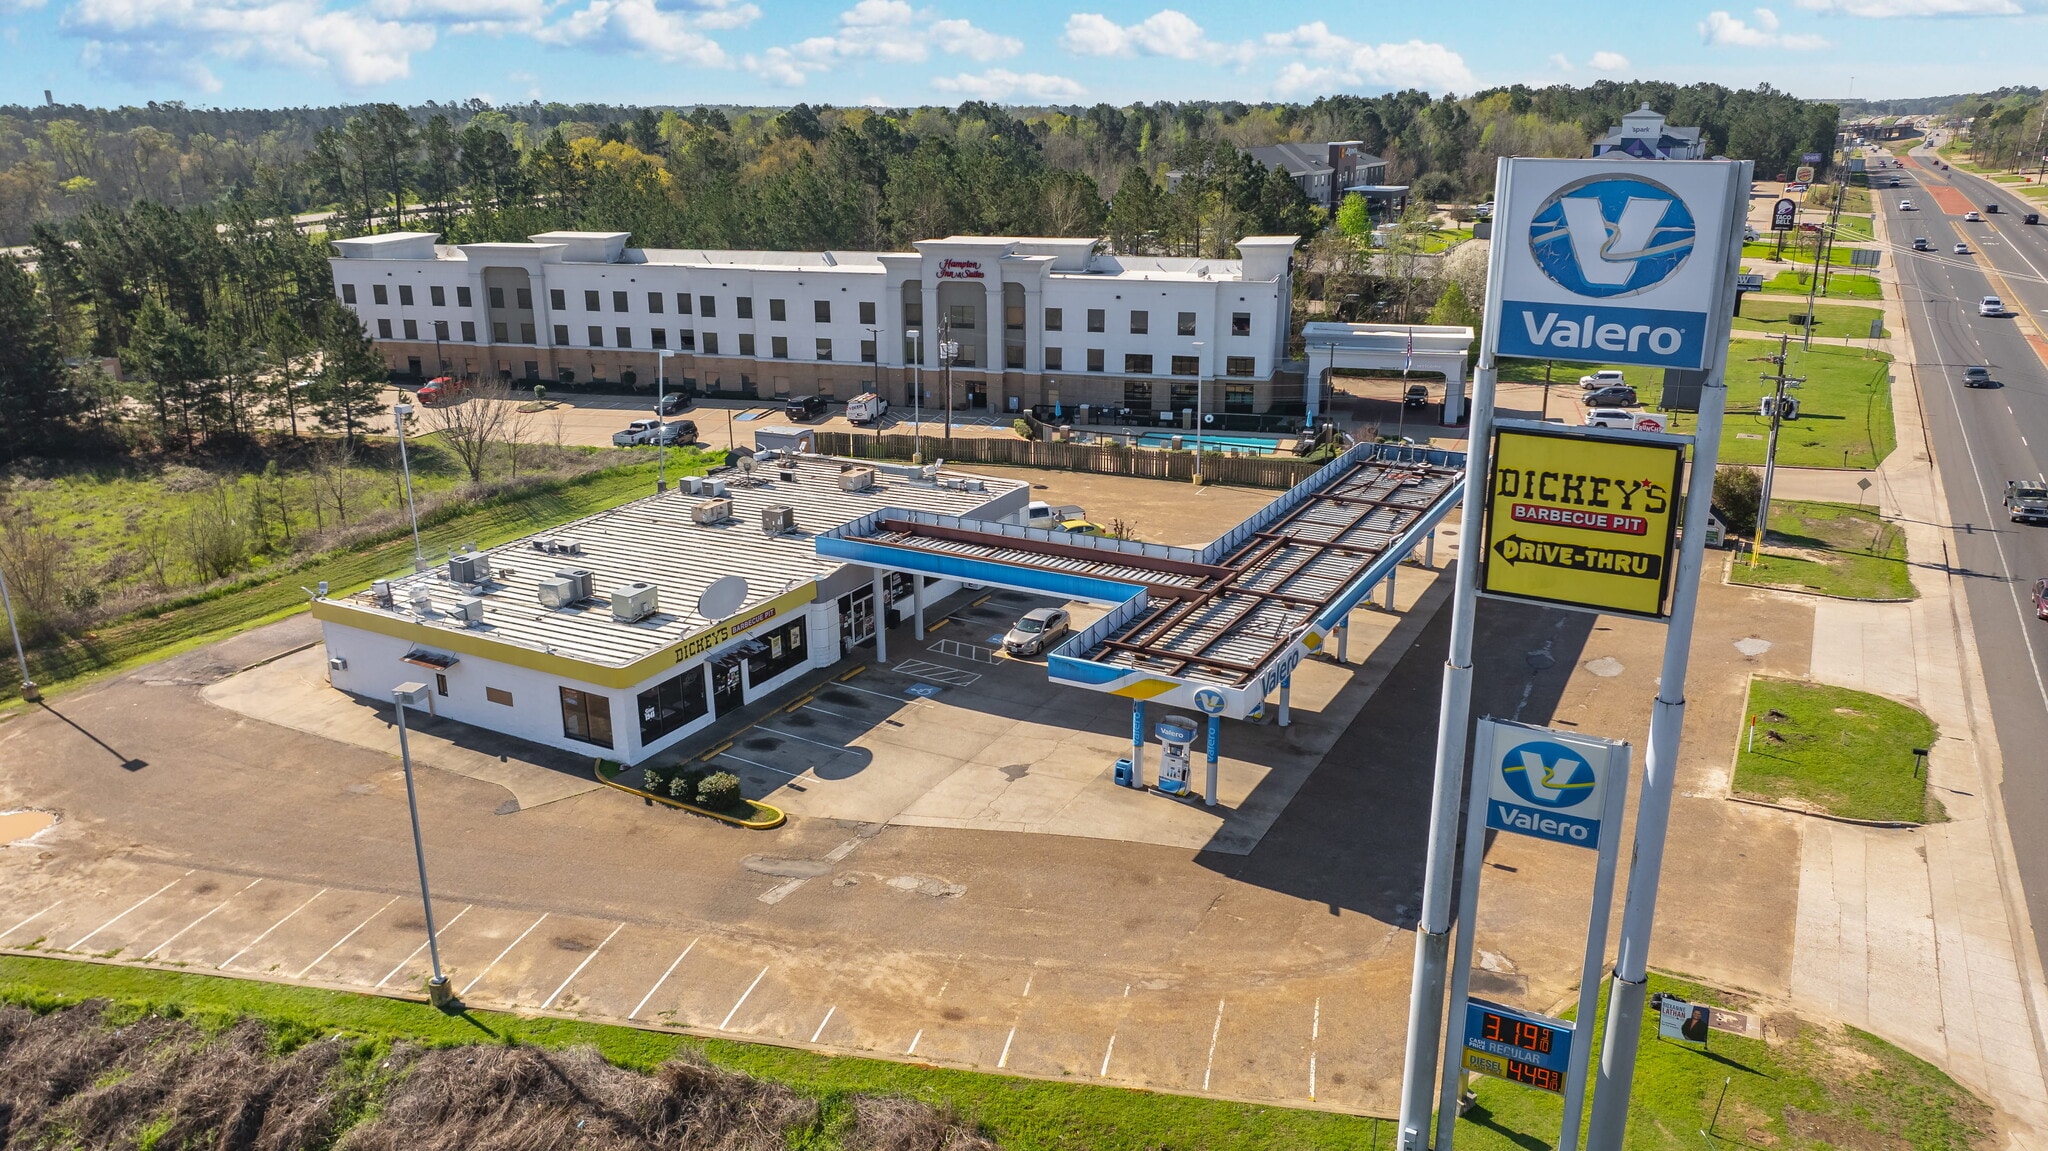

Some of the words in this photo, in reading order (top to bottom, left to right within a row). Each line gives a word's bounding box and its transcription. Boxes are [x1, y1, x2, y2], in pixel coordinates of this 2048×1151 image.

[1632, 126, 1650, 134] spark
[936, 269, 956, 278] Inn
[962, 269, 984, 278] Suites
[939, 259, 981, 269] Hampton
[1522, 310, 1683, 355] Valero
[1515, 506, 1607, 528] BARBECUE
[1613, 518, 1642, 531] PIT
[732, 614, 763, 634] BARBECUE
[764, 609, 775, 619] PIT
[1262, 650, 1298, 697] Valero
[1160, 727, 1184, 739] Valero
[1499, 805, 1588, 840] Valero
[1469, 1037, 1485, 1045] CASH
[1486, 1014, 1538, 1050] 3.19
[1469, 1042, 1485, 1050] PRICE
[1488, 1043, 1540, 1064] REGULAR
[1470, 1055, 1502, 1070] DIESEL
[1509, 1060, 1549, 1088] 4.49
